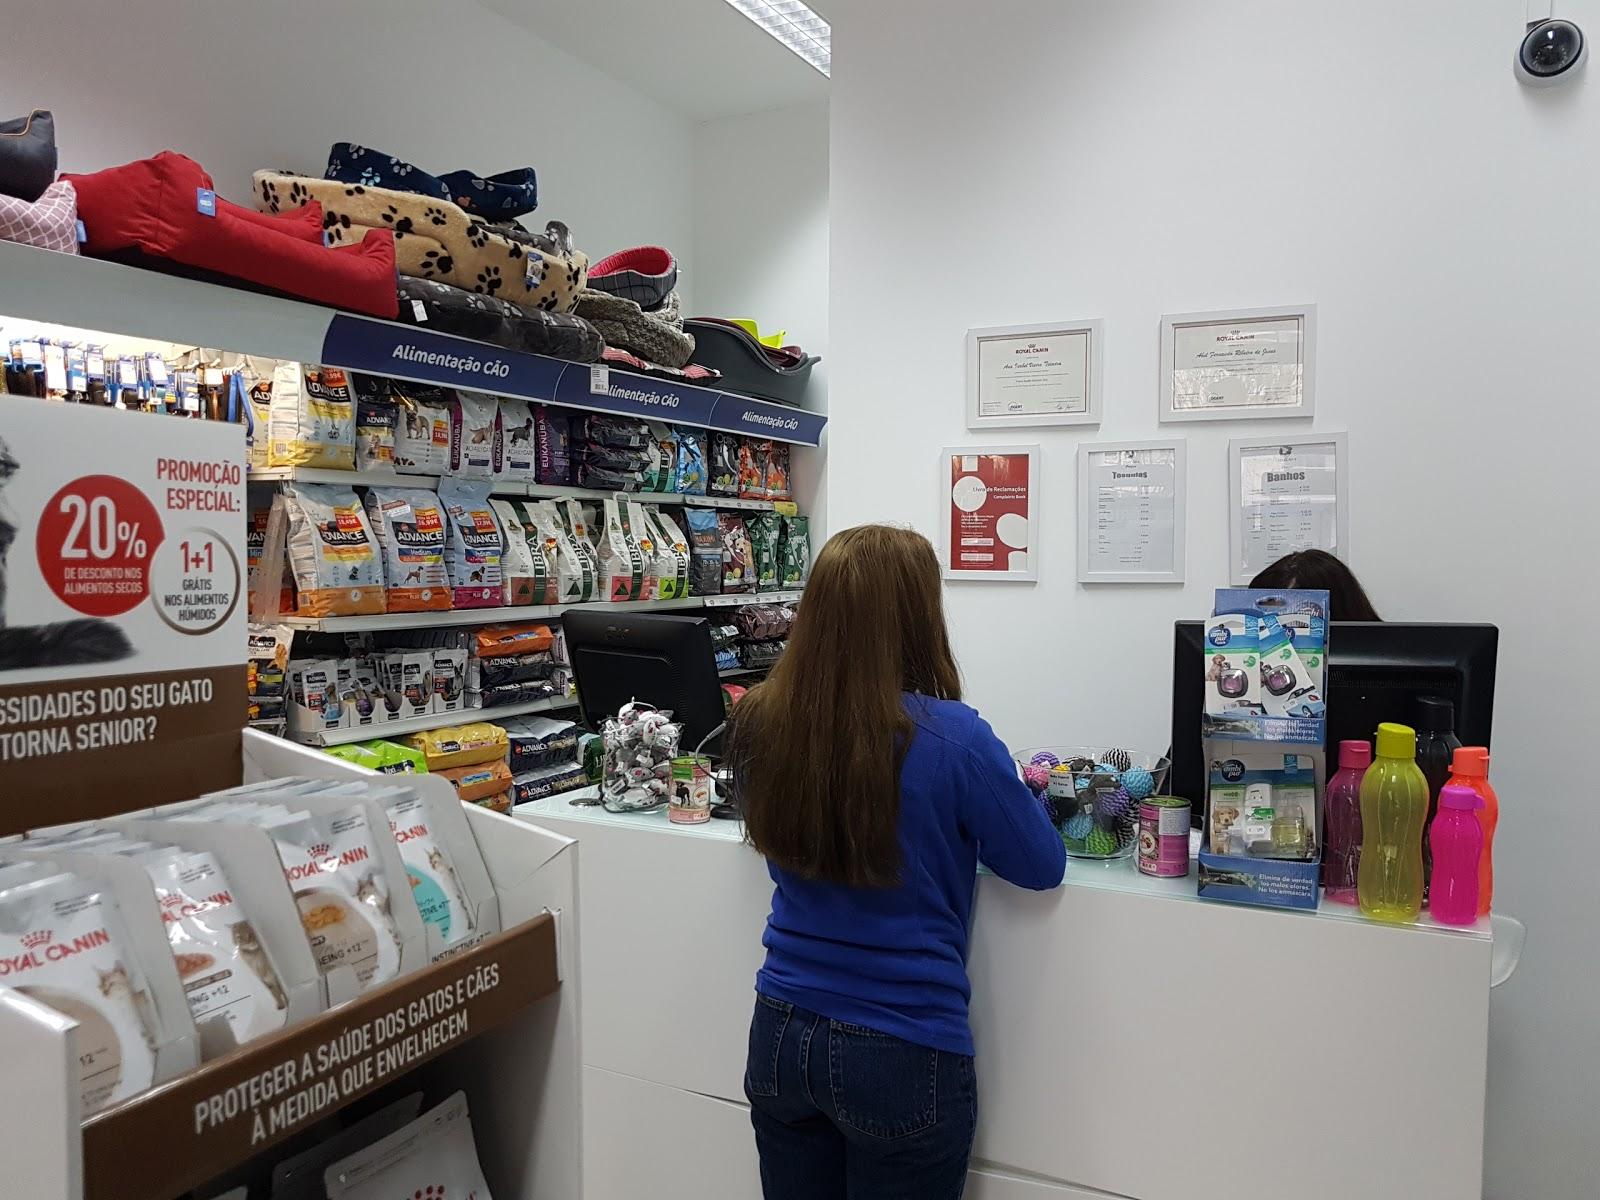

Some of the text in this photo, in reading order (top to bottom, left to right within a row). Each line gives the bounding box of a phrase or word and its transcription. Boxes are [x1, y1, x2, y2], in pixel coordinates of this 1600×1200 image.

[392, 344, 510, 378] Alimentação CÃO
[307, 381, 347, 398] ADVANCE
[608, 385, 680, 408] limentação CÃO
[742, 411, 799, 431] Alimentação CÃO
[452, 424, 461, 464] EUKANUBA
[541, 418, 549, 468] EUKANUBA
[157, 457, 241, 488] PROMOÇÃO
[1267, 472, 1306, 482] Banhos
[167, 487, 241, 513] ESPECIAL:
[59, 494, 147, 560] 20%
[321, 530, 365, 542] ADVANCE
[398, 530, 443, 542] ADVANCE
[464, 533, 499, 544] ADVANCE
[180, 541, 214, 574] 1+1
[527, 535, 546, 578] LIBRA
[566, 533, 591, 571] LIBRA
[624, 535, 643, 574] LIBRA
[64, 567, 142, 580] DE DESCONTO NOS
[182, 578, 212, 592] GRÁTIS
[64, 581, 143, 595] ALIMENTOS SECOS
[164, 593, 229, 607] NOS ALIMENTOS
[178, 607, 216, 622] HÚMIDOS
[101, 687, 126, 713] DO
[130, 682, 165, 710] SEU
[169, 678, 213, 706] GATO
[0, 716, 158, 761] TORNA SENIOR?
[521, 743, 548, 755] ADVANCE
[527, 784, 552, 798] ADVANCE
[395, 824, 428, 844] CANIN
[1259, 873, 1281, 881] Elimina
[46, 928, 110, 962] CANIN
[194, 963, 499, 1135] PROTEGER A SAÚDE DOS GATOS E CÃES
[251, 1009, 468, 1146] À MEDIDA QUE ENVELHECEM
